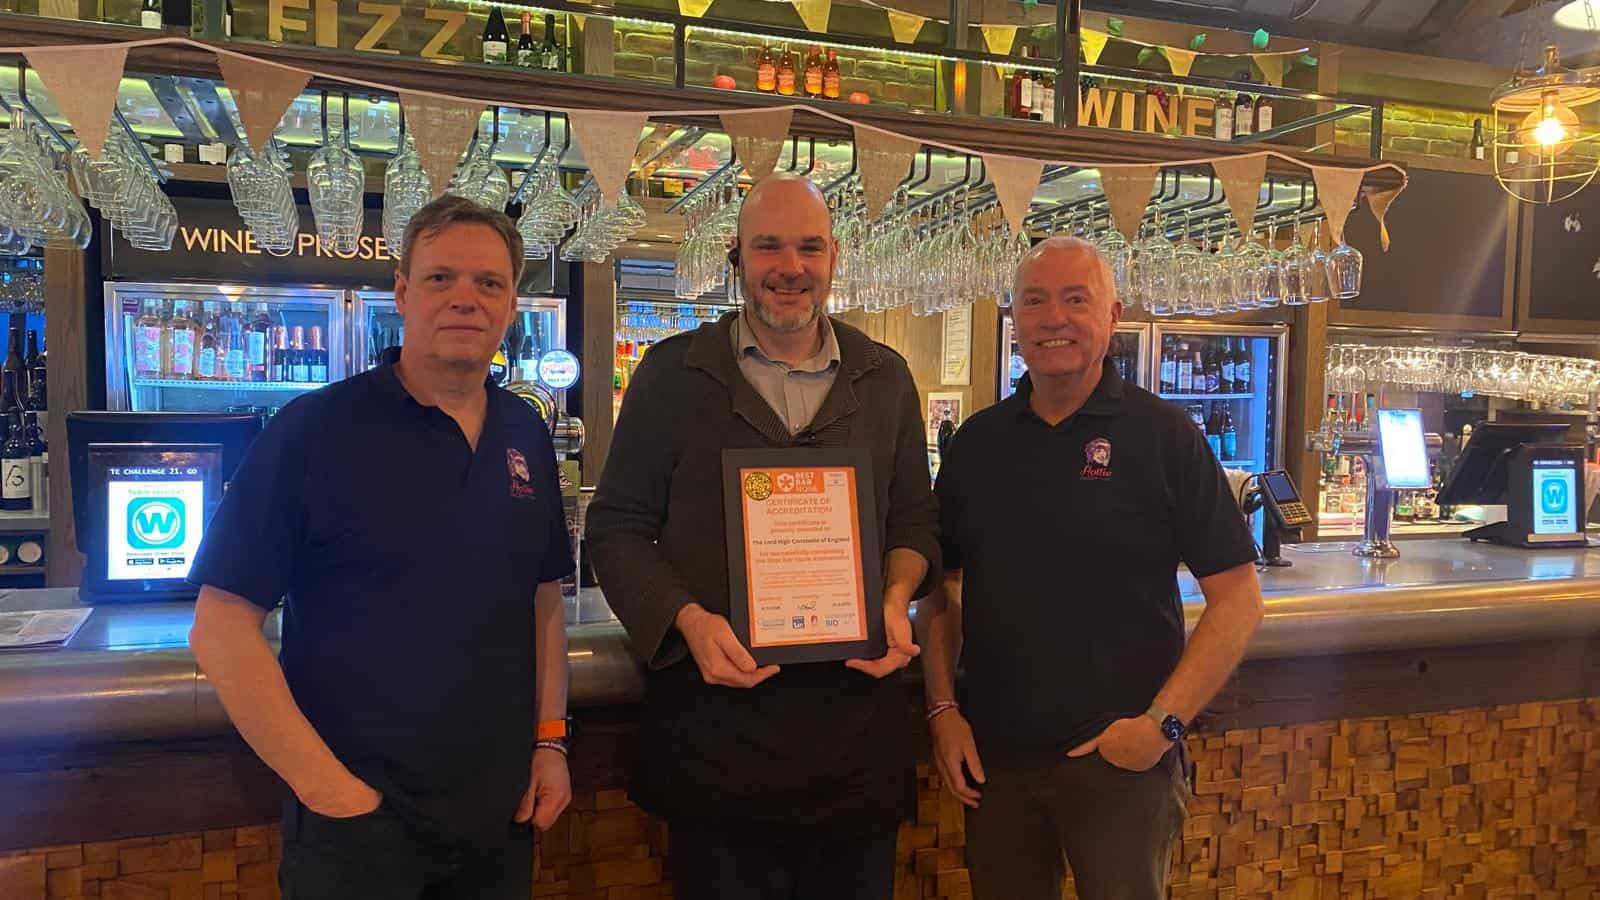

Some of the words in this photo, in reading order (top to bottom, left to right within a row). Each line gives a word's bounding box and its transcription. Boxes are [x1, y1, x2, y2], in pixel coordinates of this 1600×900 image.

[269, 0, 466, 61] FIZZ
[1078, 88, 1216, 137] WINE
[180, 226, 262, 255] WINE
[123, 468, 166, 476] CHALLENGE
[767, 498, 820, 506] CERTIFICATE
[766, 506, 833, 515] ACCREDITATION
[136, 511, 178, 534] W
[828, 536, 850, 545] England
